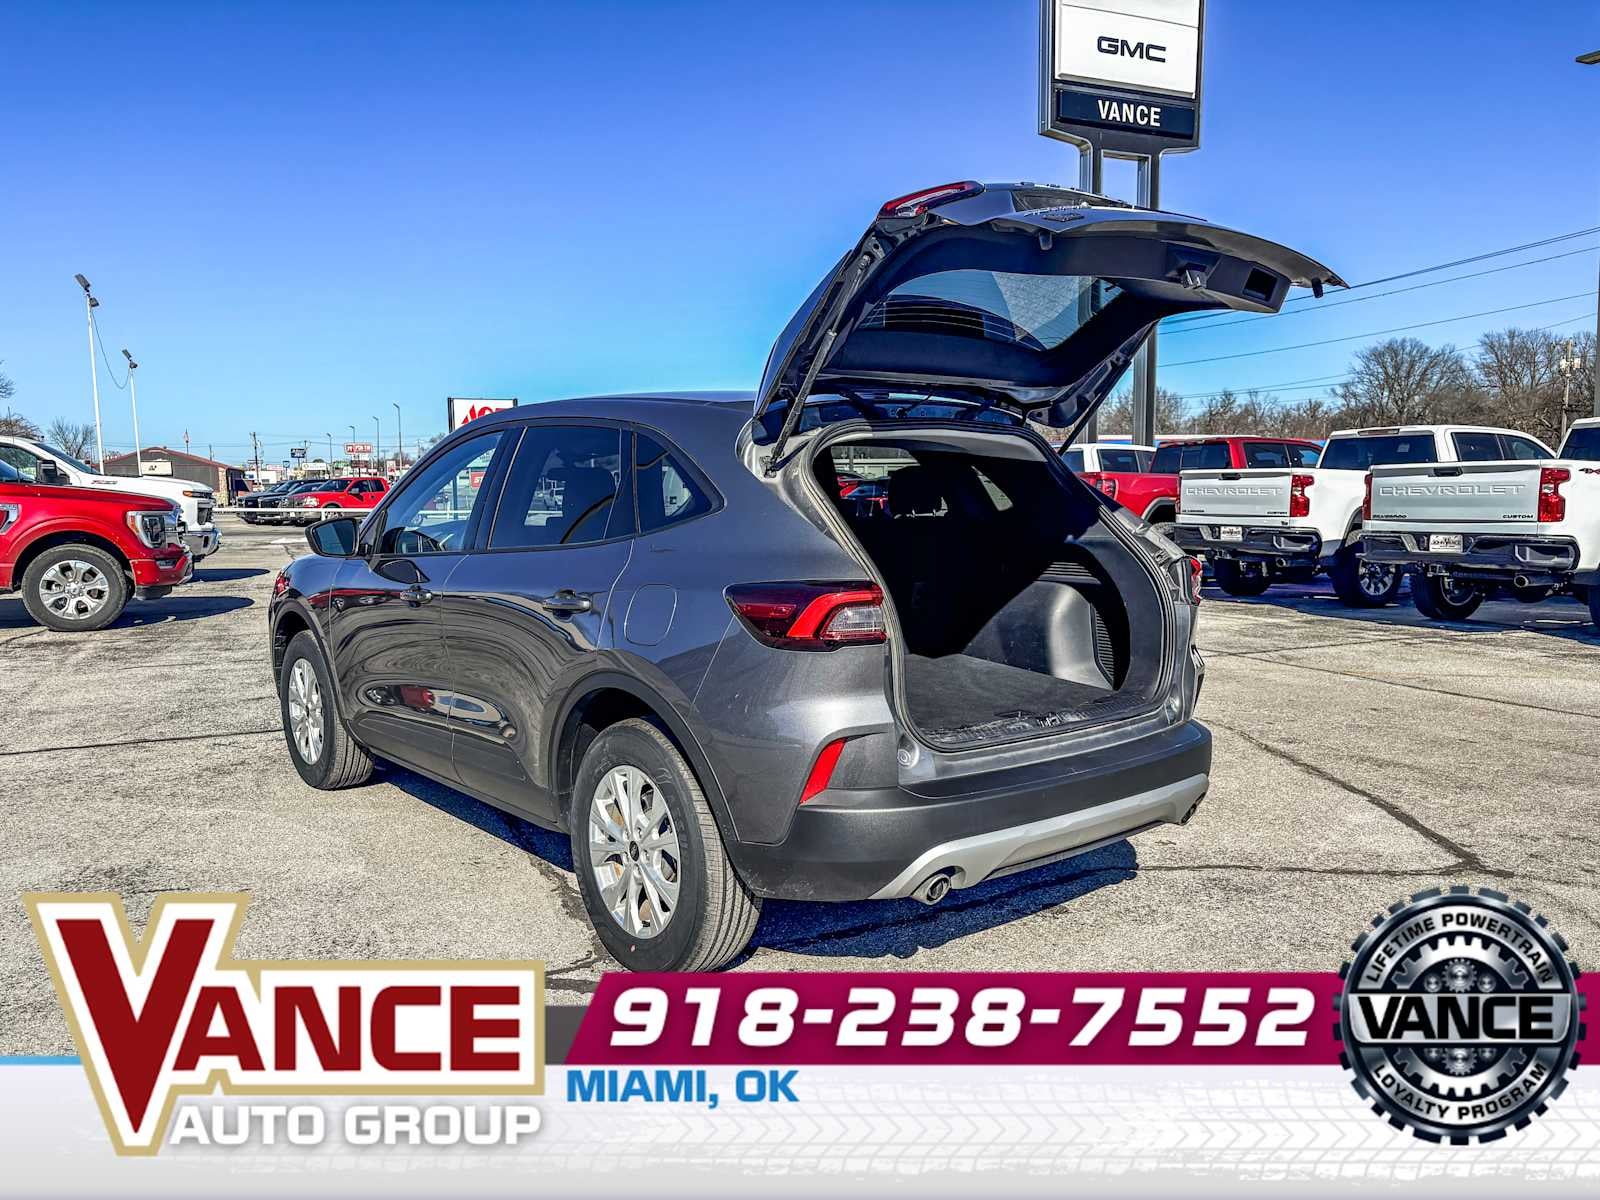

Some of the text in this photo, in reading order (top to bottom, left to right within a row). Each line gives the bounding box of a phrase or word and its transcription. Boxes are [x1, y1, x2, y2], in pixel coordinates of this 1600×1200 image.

[1097, 36, 1167, 63] GMC
[1097, 99, 1161, 127] VANCE
[1185, 486, 1282, 496] CHEVROLET
[1379, 484, 1526, 496] CHEVROLET
